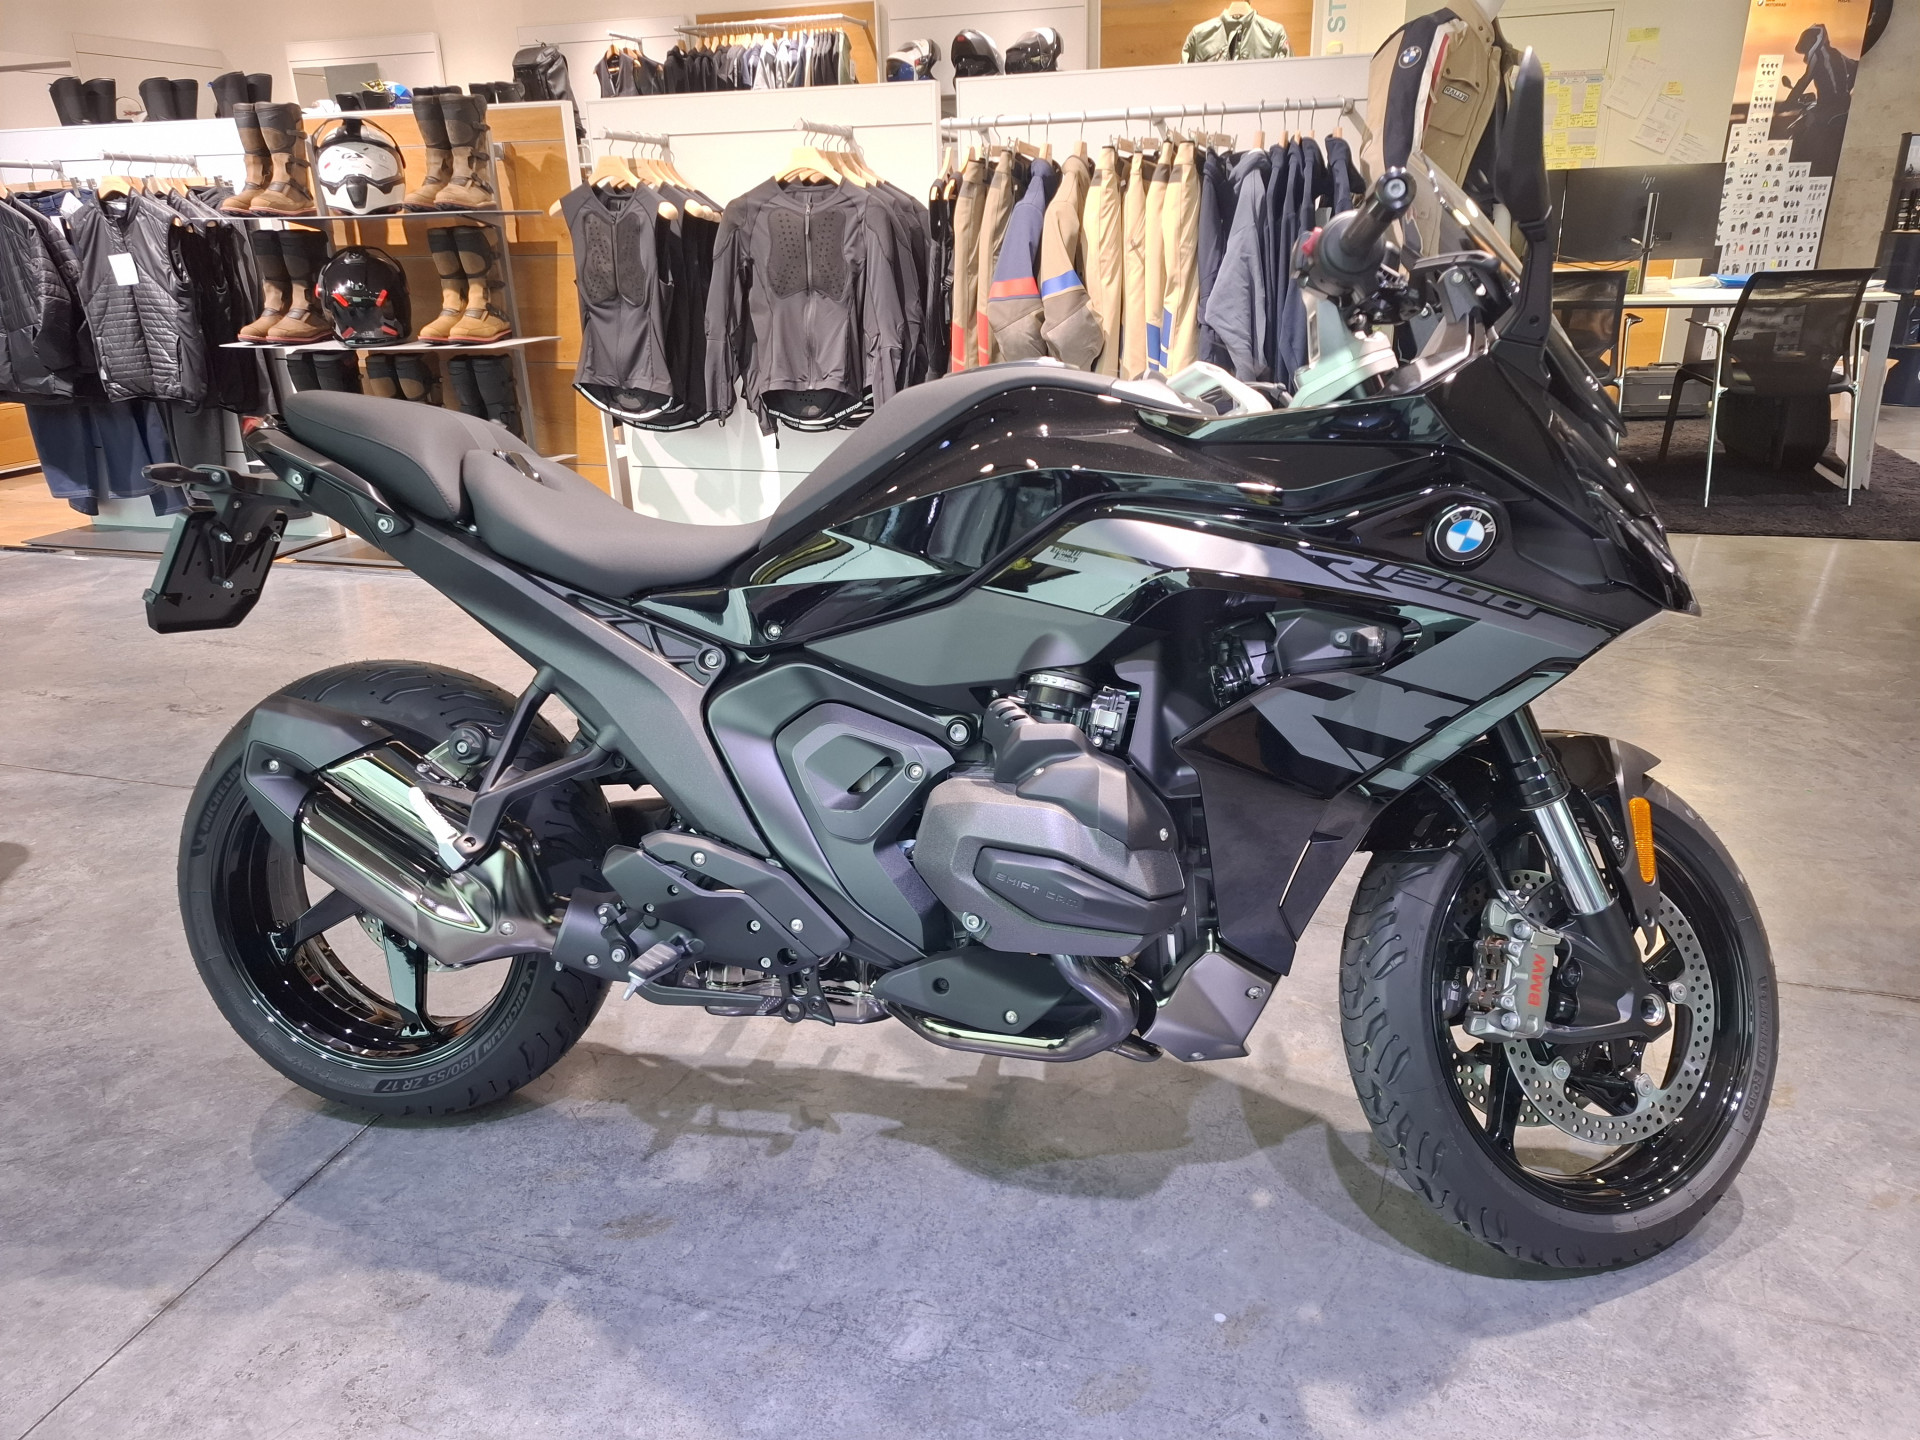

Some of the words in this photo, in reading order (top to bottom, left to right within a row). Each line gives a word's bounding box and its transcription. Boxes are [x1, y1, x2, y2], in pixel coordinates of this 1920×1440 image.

[1449, 510, 1495, 534] BMW
[995, 871, 1040, 893] SHIFT
[1528, 953, 1547, 1007] BMW
[482, 986, 528, 1053] MICHELIN
[1758, 998, 1769, 1065] MICHELIN
[427, 1054, 476, 1085] 190/55
[380, 1080, 399, 1092] 17
[402, 1077, 423, 1091] ZR
[1750, 1075, 1762, 1110] ROAD
[1743, 1108, 1752, 1120] 6
